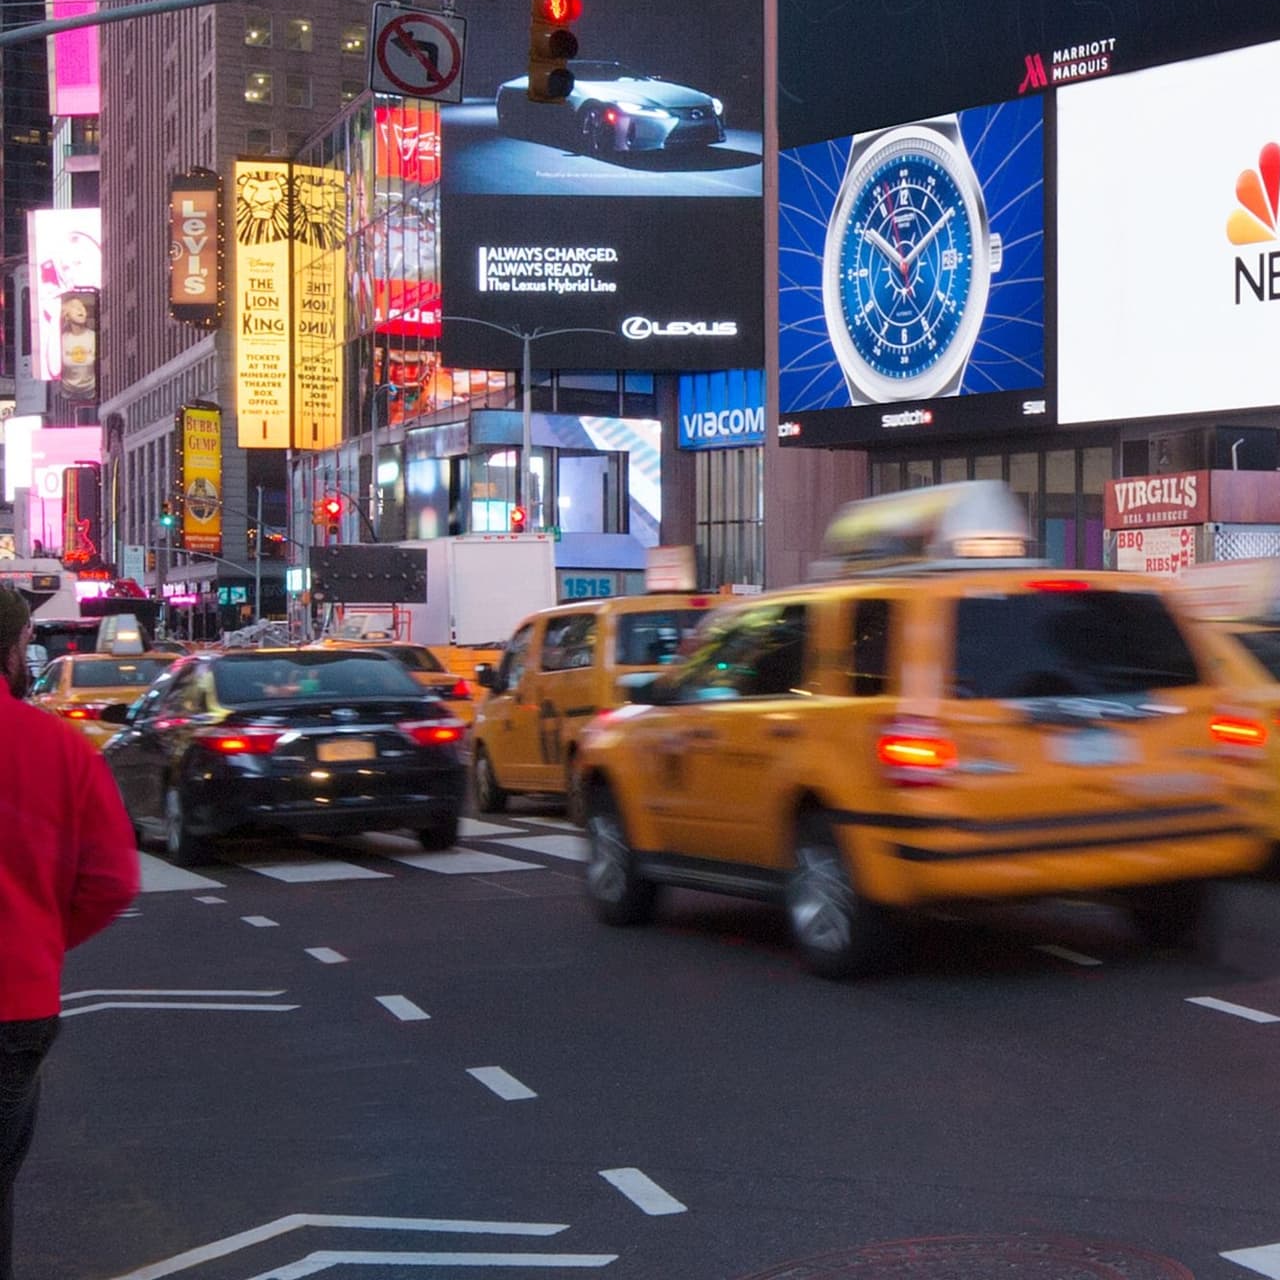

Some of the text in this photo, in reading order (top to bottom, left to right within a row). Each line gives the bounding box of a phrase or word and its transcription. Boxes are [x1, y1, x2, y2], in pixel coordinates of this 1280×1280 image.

[1053, 38, 1116, 64] MARRIOTT
[1053, 57, 1108, 80] MARQUIS
[487, 247, 618, 262] ALWAYS CHARGED.
[487, 263, 593, 277] ALWAYS READY.
[249, 278, 273, 289] THE
[488, 278, 617, 294] The Lexus Hybrid Line
[652, 321, 738, 336] LEXUS
[186, 415, 219, 433] BUBBA
[188, 434, 217, 453] GUMP
[1115, 476, 1197, 513] VIRGIL'S
[1123, 512, 1143, 524] REAL
[1118, 531, 1144, 552] BBQ
[1146, 557, 1170, 572] RIBS
[564, 578, 611, 597] 1515
